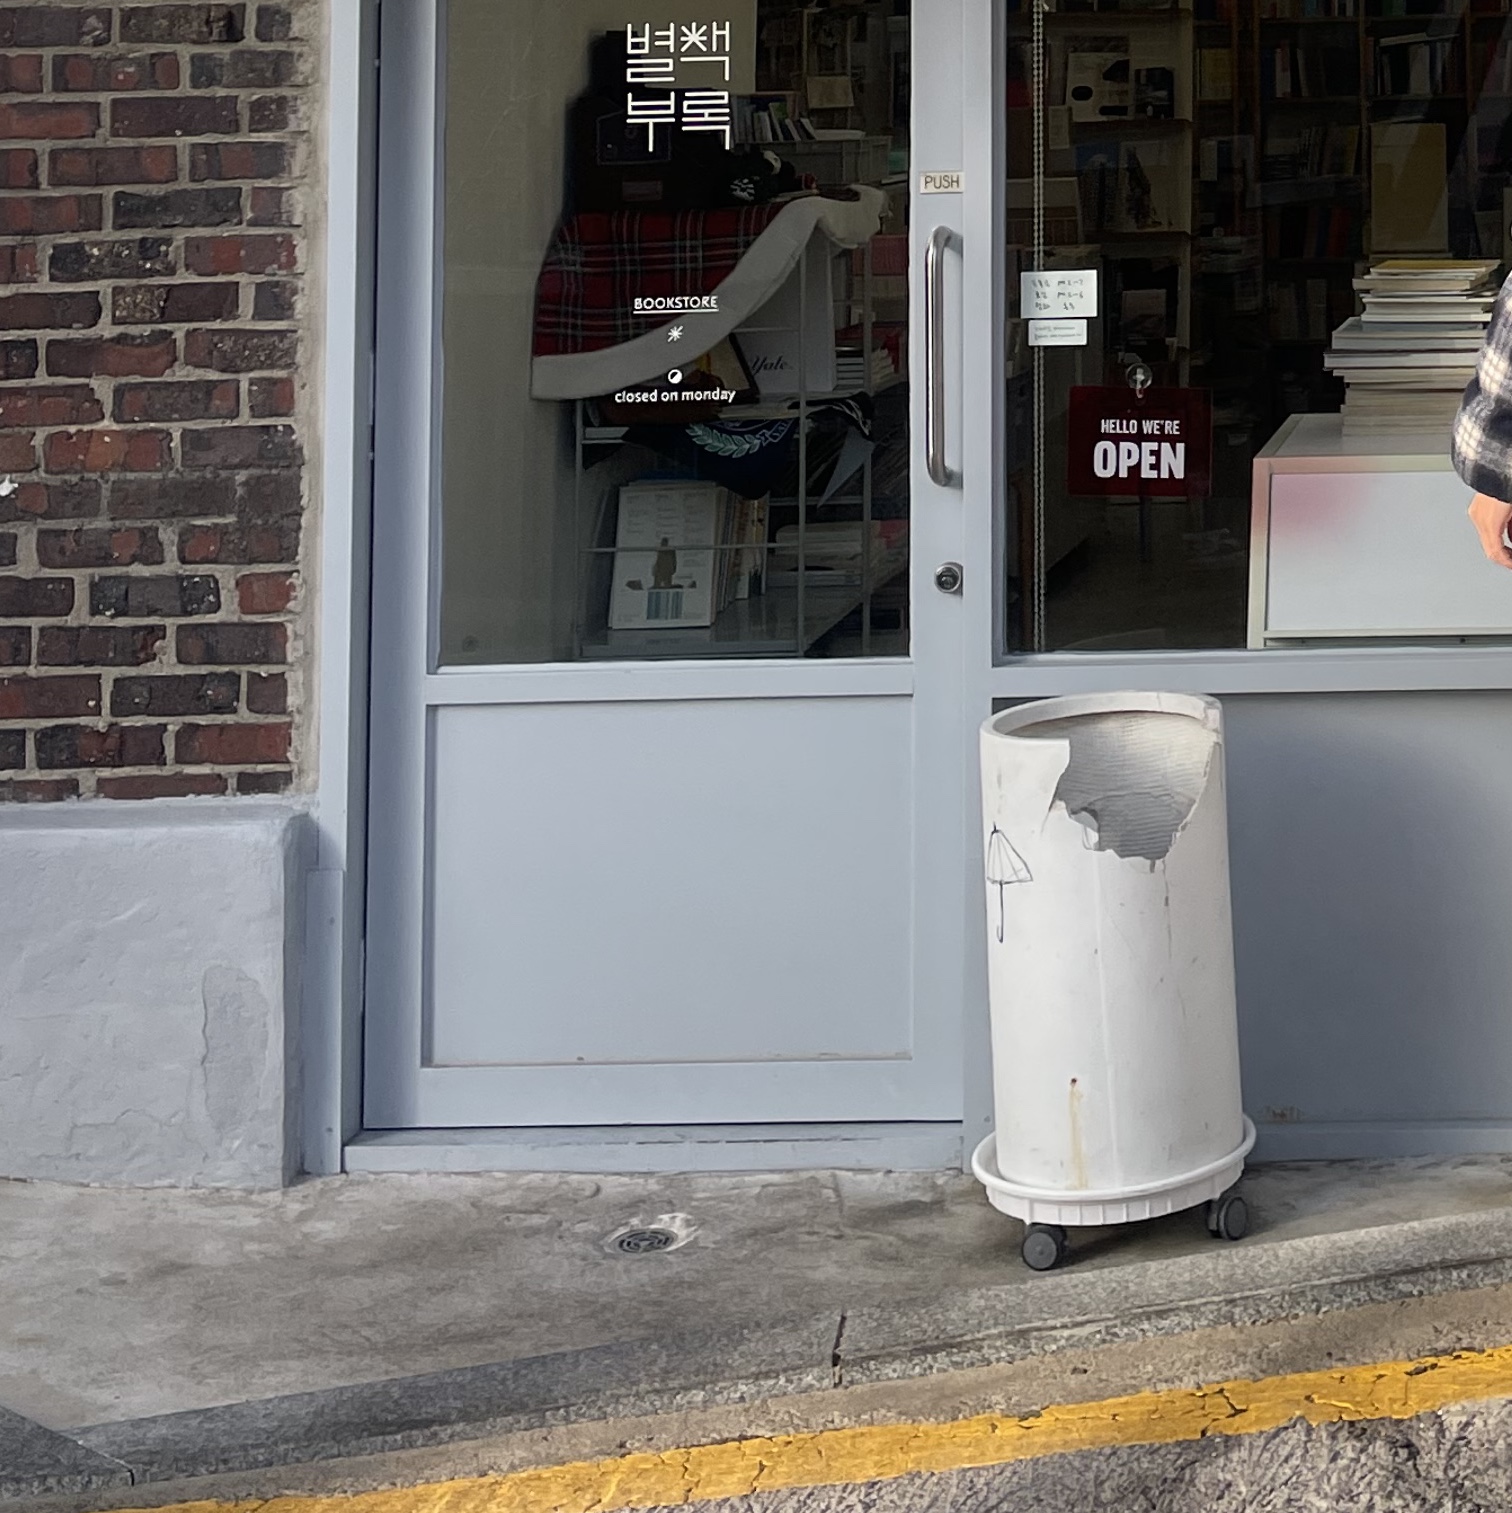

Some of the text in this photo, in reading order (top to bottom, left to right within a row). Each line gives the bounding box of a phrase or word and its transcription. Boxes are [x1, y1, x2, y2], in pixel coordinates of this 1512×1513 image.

[626, 21, 730, 82] 별책
[626, 91, 730, 152] 부록
[924, 174, 960, 190] PUSH
[633, 295, 719, 311] BOOKSTORE
[614, 387, 736, 403] closed on monday
[1100, 419, 1181, 435] HELLO WE'RE
[1093, 440, 1185, 479] OPEN
